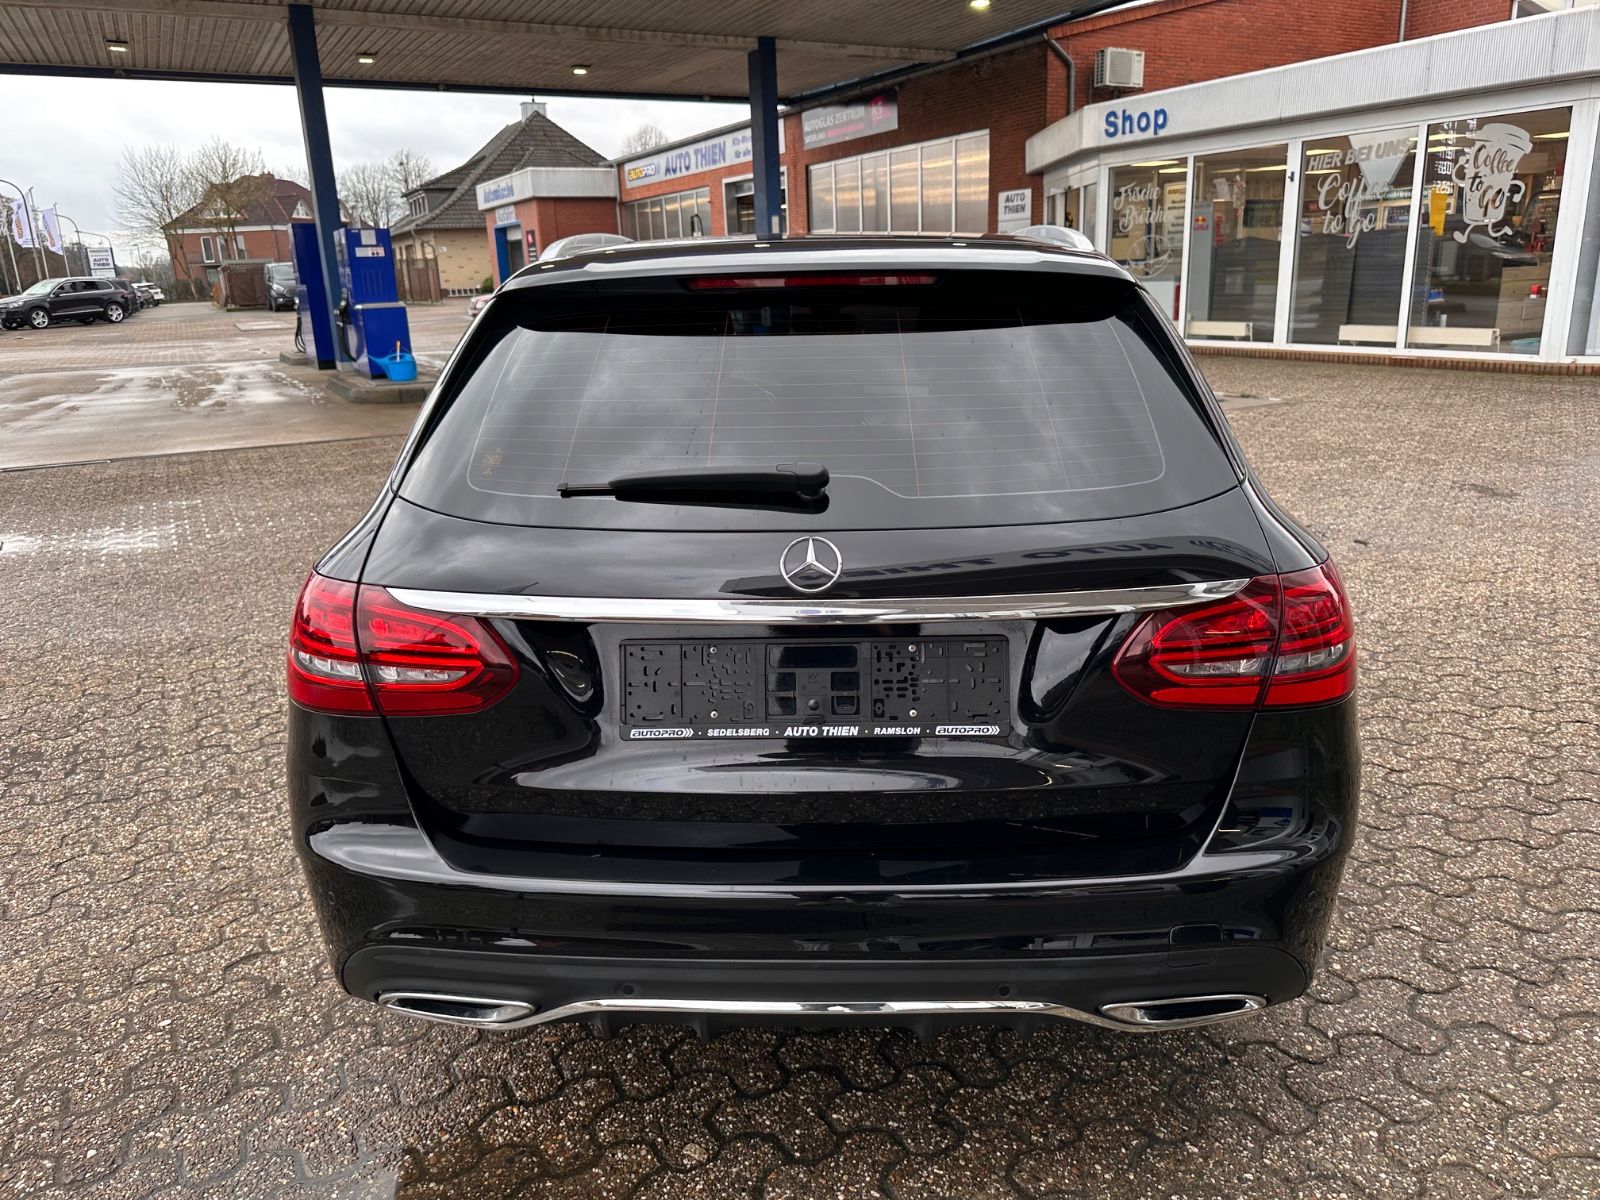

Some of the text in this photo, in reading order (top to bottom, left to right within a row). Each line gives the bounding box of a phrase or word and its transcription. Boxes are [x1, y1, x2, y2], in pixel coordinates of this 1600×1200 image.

[1104, 108, 1168, 138] Shop
[664, 140, 726, 177] AUTO THIEN
[1307, 138, 1413, 171] HIER BEI UNS
[1472, 143, 1514, 175] Coffee
[1113, 181, 1161, 211] Frische
[1467, 171, 1485, 193] to
[1003, 203, 1026, 215] THIEN
[1004, 192, 1026, 203] AUTO
[1321, 210, 1376, 249] to go
[707, 728, 770, 737] SEDELSBERG
[784, 726, 818, 737] AUTO
[822, 726, 859, 736] THIEN
[874, 727, 921, 735] RAMSLOH
